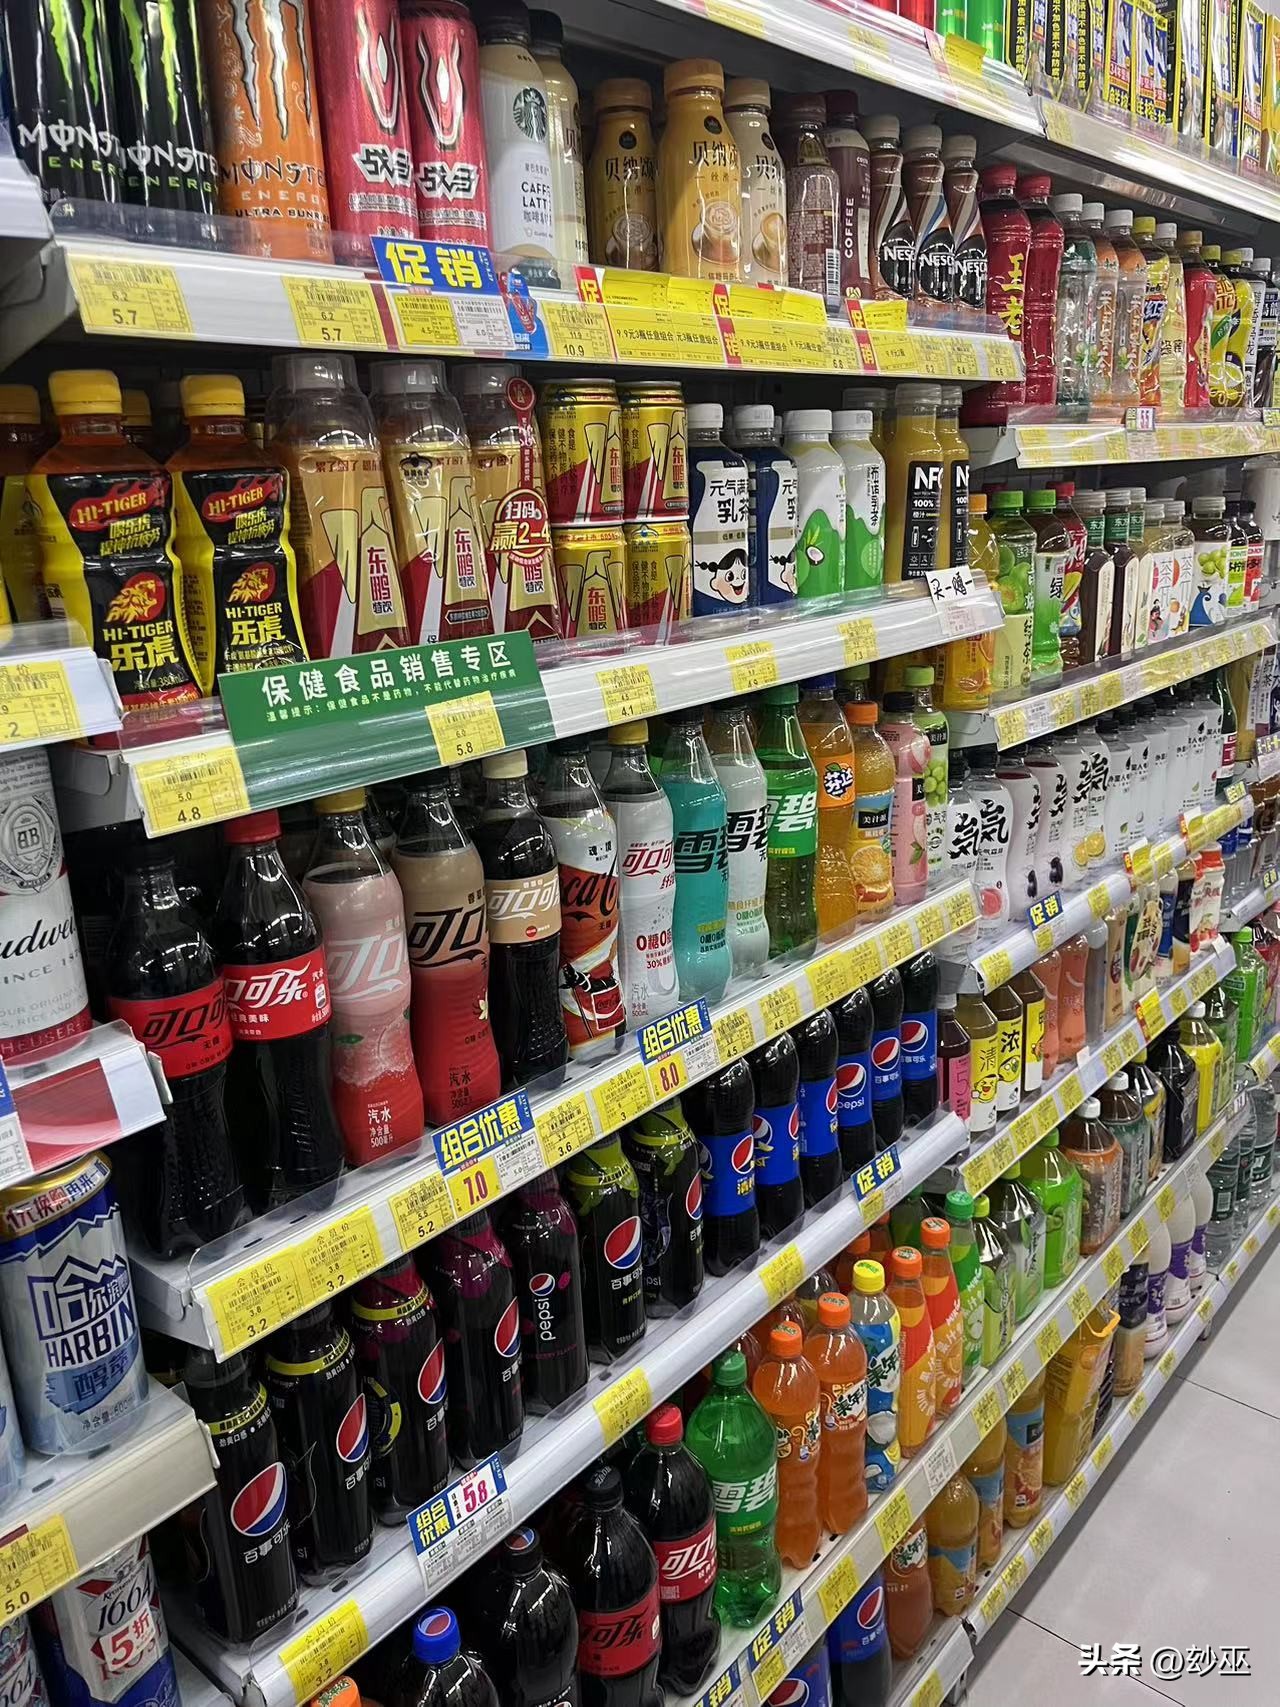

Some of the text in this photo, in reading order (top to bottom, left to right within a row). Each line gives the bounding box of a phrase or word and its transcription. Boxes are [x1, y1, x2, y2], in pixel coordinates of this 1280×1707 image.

[844, 197, 855, 259] COFFEE
[386, 242, 484, 289] 促销
[112, 307, 138, 326] 5.7
[321, 311, 335, 321] 6.2
[321, 327, 342, 341] 5.7
[563, 342, 586, 357] 10.9
[77, 491, 148, 526] HI-TIGER
[208, 486, 264, 517] HI-TIGER
[505, 500, 535, 521] 扫码
[453, 528, 476, 577] 东鹏
[367, 546, 391, 601] 东鹏
[458, 575, 476, 588] 特饮
[525, 580, 545, 594] 特饮
[225, 602, 283, 619] HI-TIGER
[372, 600, 394, 614] 特饮
[587, 587, 607, 622] 东鹏
[103, 619, 174, 642] HI-TIGER
[230, 615, 286, 646] 乐虎
[110, 635, 179, 673] 乐虎
[261, 640, 513, 709] 保健食品销售专区
[620, 705, 635, 717] 4.1
[456, 741, 474, 757] 5.8
[177, 790, 193, 802] 5.0
[824, 771, 855, 796] 芬达
[177, 806, 202, 824] 4.8
[1029, 894, 1060, 926] 促销
[643, 1004, 704, 1060] 组合优惠
[1000, 1029, 1021, 1054] 浓
[726, 1045, 739, 1058] 4.5
[449, 1070, 471, 1084] 汽水
[660, 1061, 680, 1092] 8.0
[367, 1105, 392, 1125] 汽水
[836, 1096, 865, 1111] pepsi
[440, 1098, 523, 1169] 组合优惠
[558, 1141, 573, 1158] 3.6
[463, 1169, 489, 1206] 7.0
[857, 1157, 895, 1195] 促销
[417, 1209, 429, 1221] 5.5
[417, 1220, 435, 1238] 5.2
[328, 1263, 341, 1274] 3.8
[326, 1274, 347, 1294] 3.2
[249, 1306, 262, 1317] 3.8
[539, 1297, 556, 1341] pepsi
[45, 1290, 136, 1368] HARBIN
[246, 1318, 269, 1339] 3.2
[462, 1479, 488, 1513] 5.8
[712, 1465, 777, 1514] 雪碧
[415, 1498, 447, 1532] 组合
[419, 1513, 451, 1548] 优惠
[4, 1590, 31, 1615] 5.0
[111, 1608, 152, 1666] 5折
[752, 1598, 797, 1661] 促销
[315, 1669, 333, 1687] 3.2
[697, 1669, 732, 1707] 销
